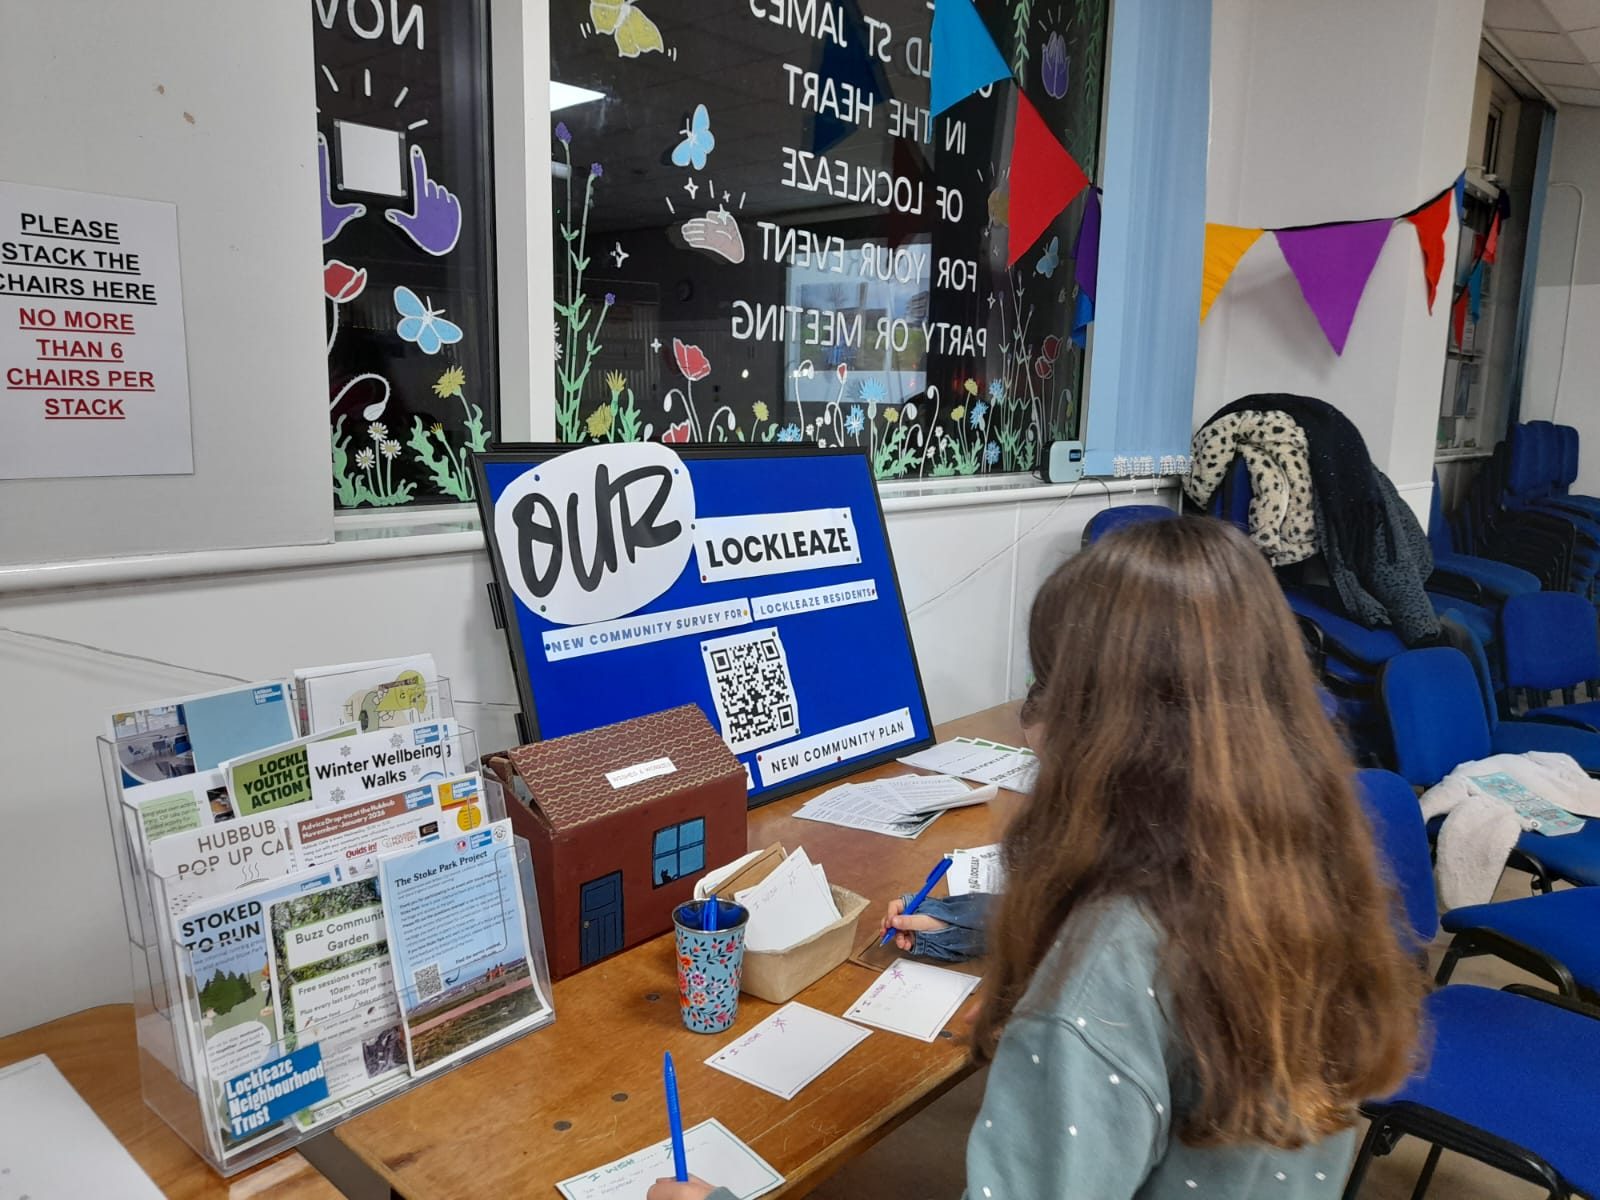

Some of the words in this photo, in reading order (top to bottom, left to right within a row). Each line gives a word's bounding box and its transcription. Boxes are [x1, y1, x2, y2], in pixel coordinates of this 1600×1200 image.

[20, 212, 119, 241] PLEASE
[2, 242, 87, 267] STACK
[94, 250, 139, 272] THE
[93, 280, 156, 301] HERE
[19, 308, 56, 327] NO
[64, 310, 134, 331] MORE
[36, 339, 103, 359] THAN
[110, 342, 124, 359] 6
[6, 368, 99, 387] CHAIRS
[108, 371, 155, 388] PER
[45, 398, 125, 416] STACK
[512, 463, 682, 598] OUR
[706, 527, 851, 568] LOCKLEAZE
[551, 635, 584, 653] NEW
[589, 620, 672, 647] COMMUNITY
[676, 612, 722, 631] SURVEY
[724, 608, 743, 622] FOR
[760, 597, 820, 616] LOCKLEAZE
[823, 587, 872, 604] RESIDENTS
[315, 758, 369, 780] Winter
[372, 744, 442, 768] Wellbeing
[771, 754, 799, 774] NEW
[804, 730, 875, 762] COMMUNITY
[879, 721, 904, 738] PLAN
[244, 770, 293, 796] YOUTH
[362, 768, 407, 790] Walks
[252, 780, 303, 809] ACTION
[302, 820, 325, 832] Advice
[360, 807, 370, 815] the
[197, 820, 276, 853] HUBBUB
[178, 855, 219, 880] POP
[228, 846, 253, 866] UP
[345, 845, 367, 859] Quids
[394, 875, 411, 888] The
[413, 868, 437, 882] Stoke
[439, 859, 458, 873] Park
[459, 850, 488, 867] Project
[182, 900, 262, 937] STOKED
[185, 937, 214, 953] TO
[219, 921, 260, 947] RUN
[295, 929, 324, 945] Buzz
[327, 933, 369, 952] Garden
[298, 985, 316, 996] Free
[318, 974, 350, 989] sessions
[351, 966, 373, 979] every
[330, 984, 351, 996] 10am
[356, 975, 377, 988] 12pm
[344, 988, 370, 1002] Saturday
[225, 1058, 294, 1100] Lockleaze
[229, 1060, 325, 1117] Neighbourhood
[231, 1105, 270, 1136] Trust
[587, 1172, 601, 1183] I
[605, 1158, 636, 1176] WISH
